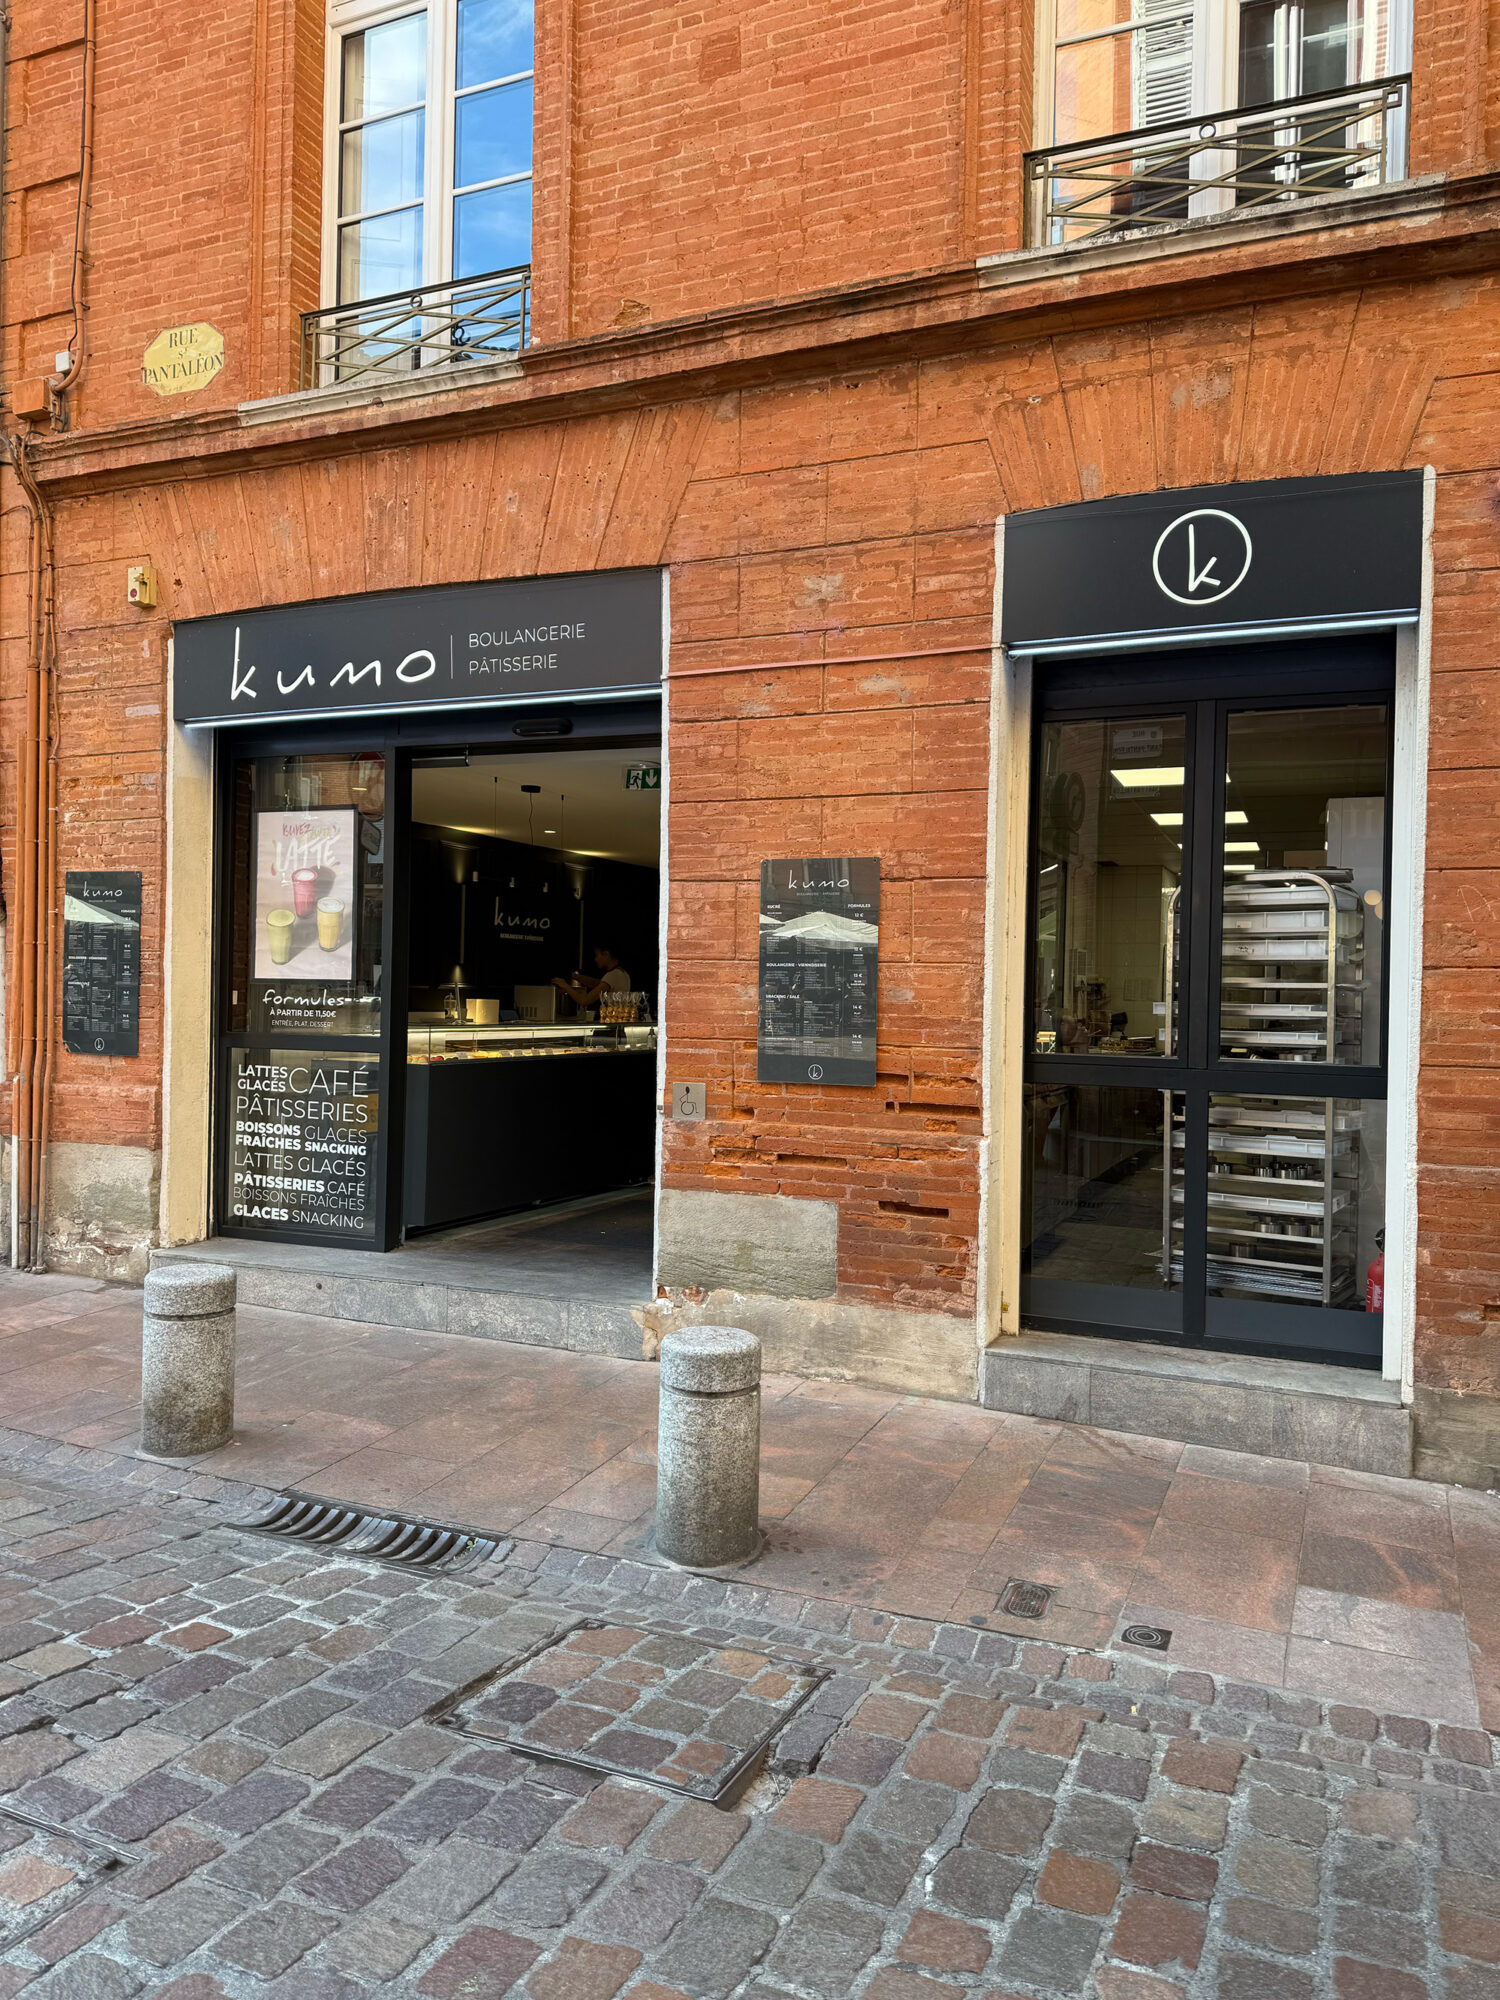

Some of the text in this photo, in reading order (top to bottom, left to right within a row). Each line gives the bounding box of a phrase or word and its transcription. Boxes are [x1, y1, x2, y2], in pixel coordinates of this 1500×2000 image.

[169, 327, 198, 348] RUE
[141, 352, 225, 384] PANTALÉON
[468, 622, 586, 648] BOULANGERIE
[230, 626, 436, 701] kumo
[468, 653, 558, 676] PÂTISSERIE
[275, 834, 341, 872] LATTE
[83, 880, 123, 897] kumo
[788, 869, 850, 889] kumo
[494, 896, 550, 929] kumo
[262, 988, 345, 1006] formules
[269, 1007, 336, 1018] À PARTIR DE 11,50€
[238, 1064, 288, 1079] LATTES
[288, 1065, 369, 1098] CAFÉ
[237, 1077, 286, 1092] GLACÉS
[236, 1093, 368, 1123] PÂTISSERIES
[235, 1133, 367, 1156] FRAÎCHES SNACKING
[236, 1120, 368, 1144] BOISSONS GLACES
[234, 1151, 366, 1177] LATTES GLACÉS
[234, 1170, 366, 1197] PÂTISSERIES CAFÉ
[233, 1186, 365, 1211] BOISSONS FRAÎCHES
[233, 1203, 364, 1229] GLACES SNACKING
